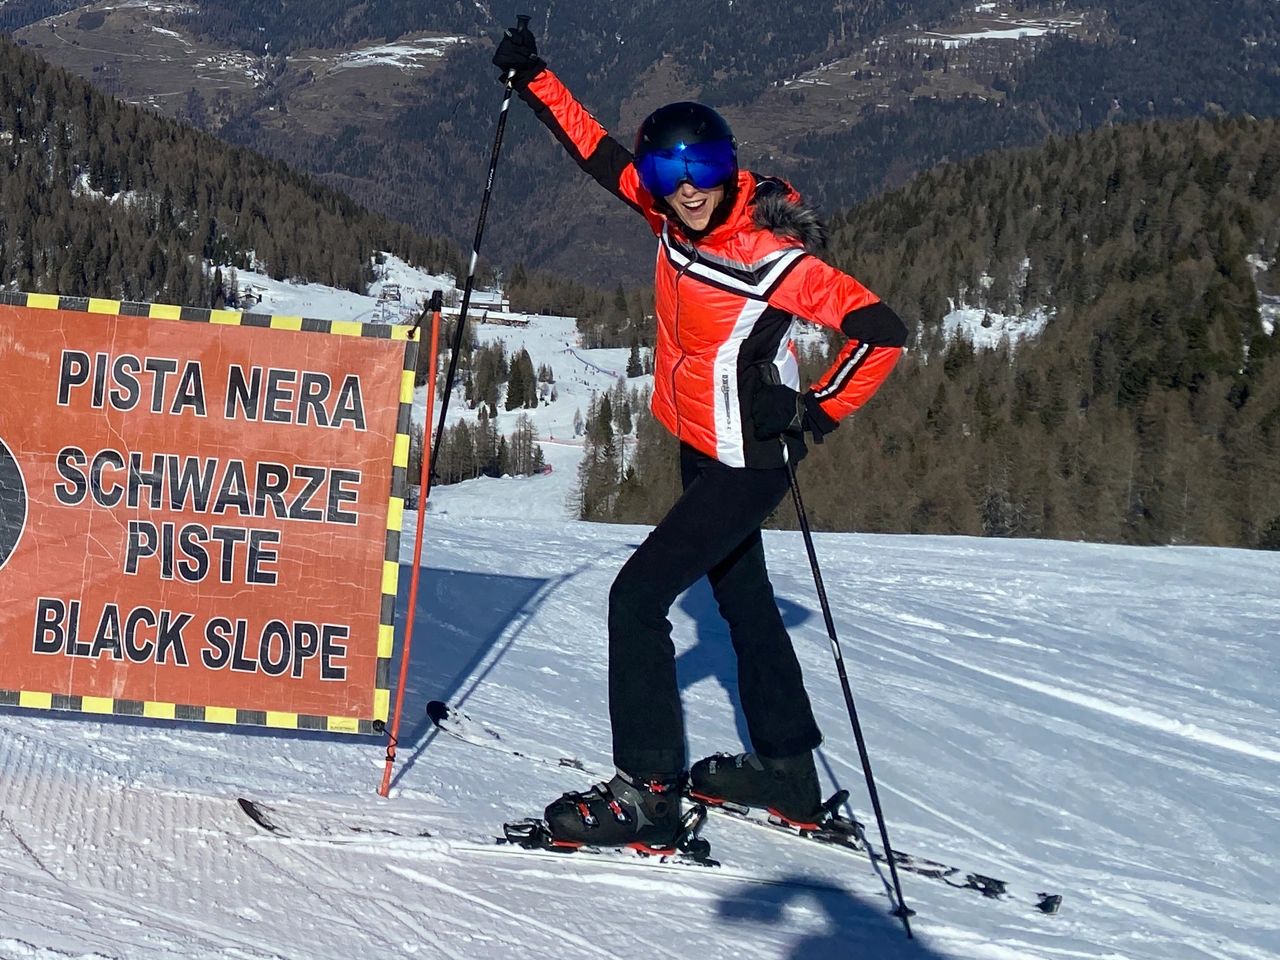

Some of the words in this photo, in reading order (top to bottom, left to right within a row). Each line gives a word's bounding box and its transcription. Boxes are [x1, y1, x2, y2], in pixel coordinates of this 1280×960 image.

[56, 349, 208, 418] PISTA
[223, 363, 367, 432] NERA
[53, 445, 362, 526] SCHWARZE
[123, 520, 282, 586] PISTE
[32, 596, 194, 667] BLACK
[200, 616, 350, 681] SLOPE
